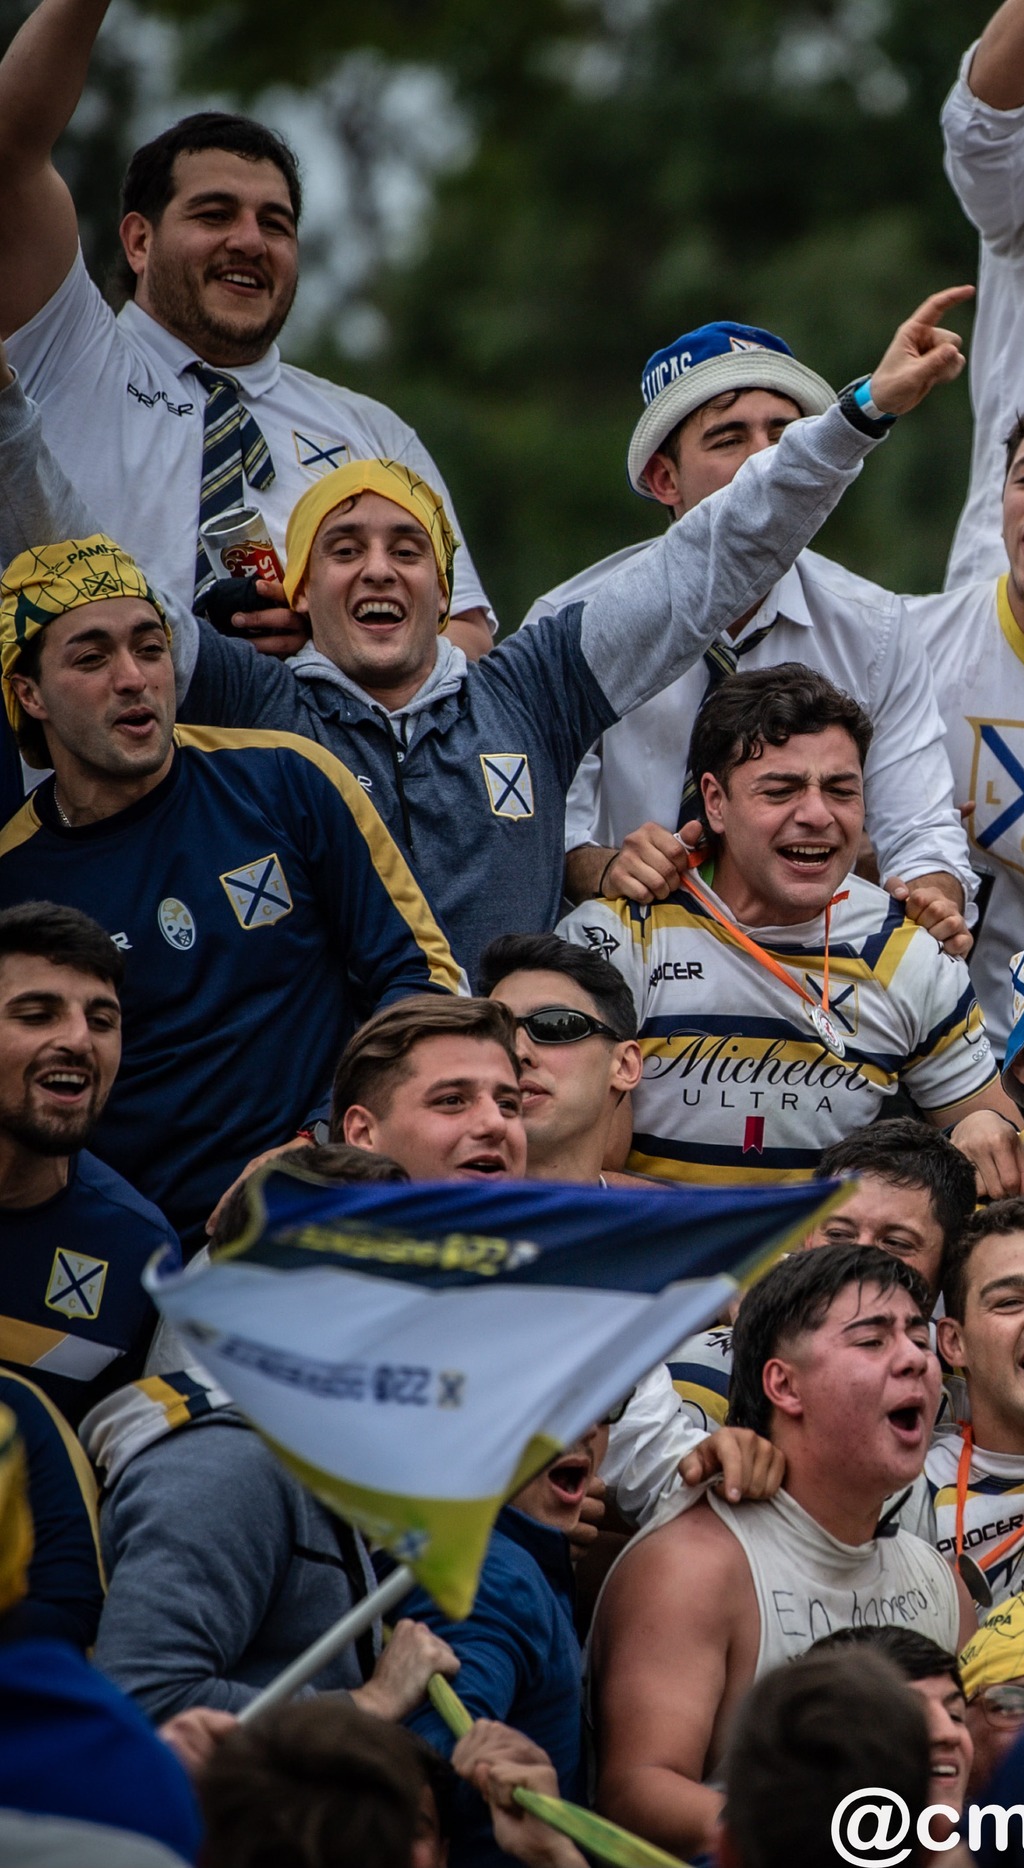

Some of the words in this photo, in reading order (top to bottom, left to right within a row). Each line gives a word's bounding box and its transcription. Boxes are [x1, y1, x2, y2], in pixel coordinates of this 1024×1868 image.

[985, 781, 1001, 806] L
[246, 869, 256, 881] T
[237, 894, 247, 905] L
[270, 879, 281, 892] T
[262, 904, 272, 916] C
[648, 961, 706, 990] ROCER
[682, 1088, 833, 1114] ULTRA
[936, 1513, 1024, 1555] PROCER
